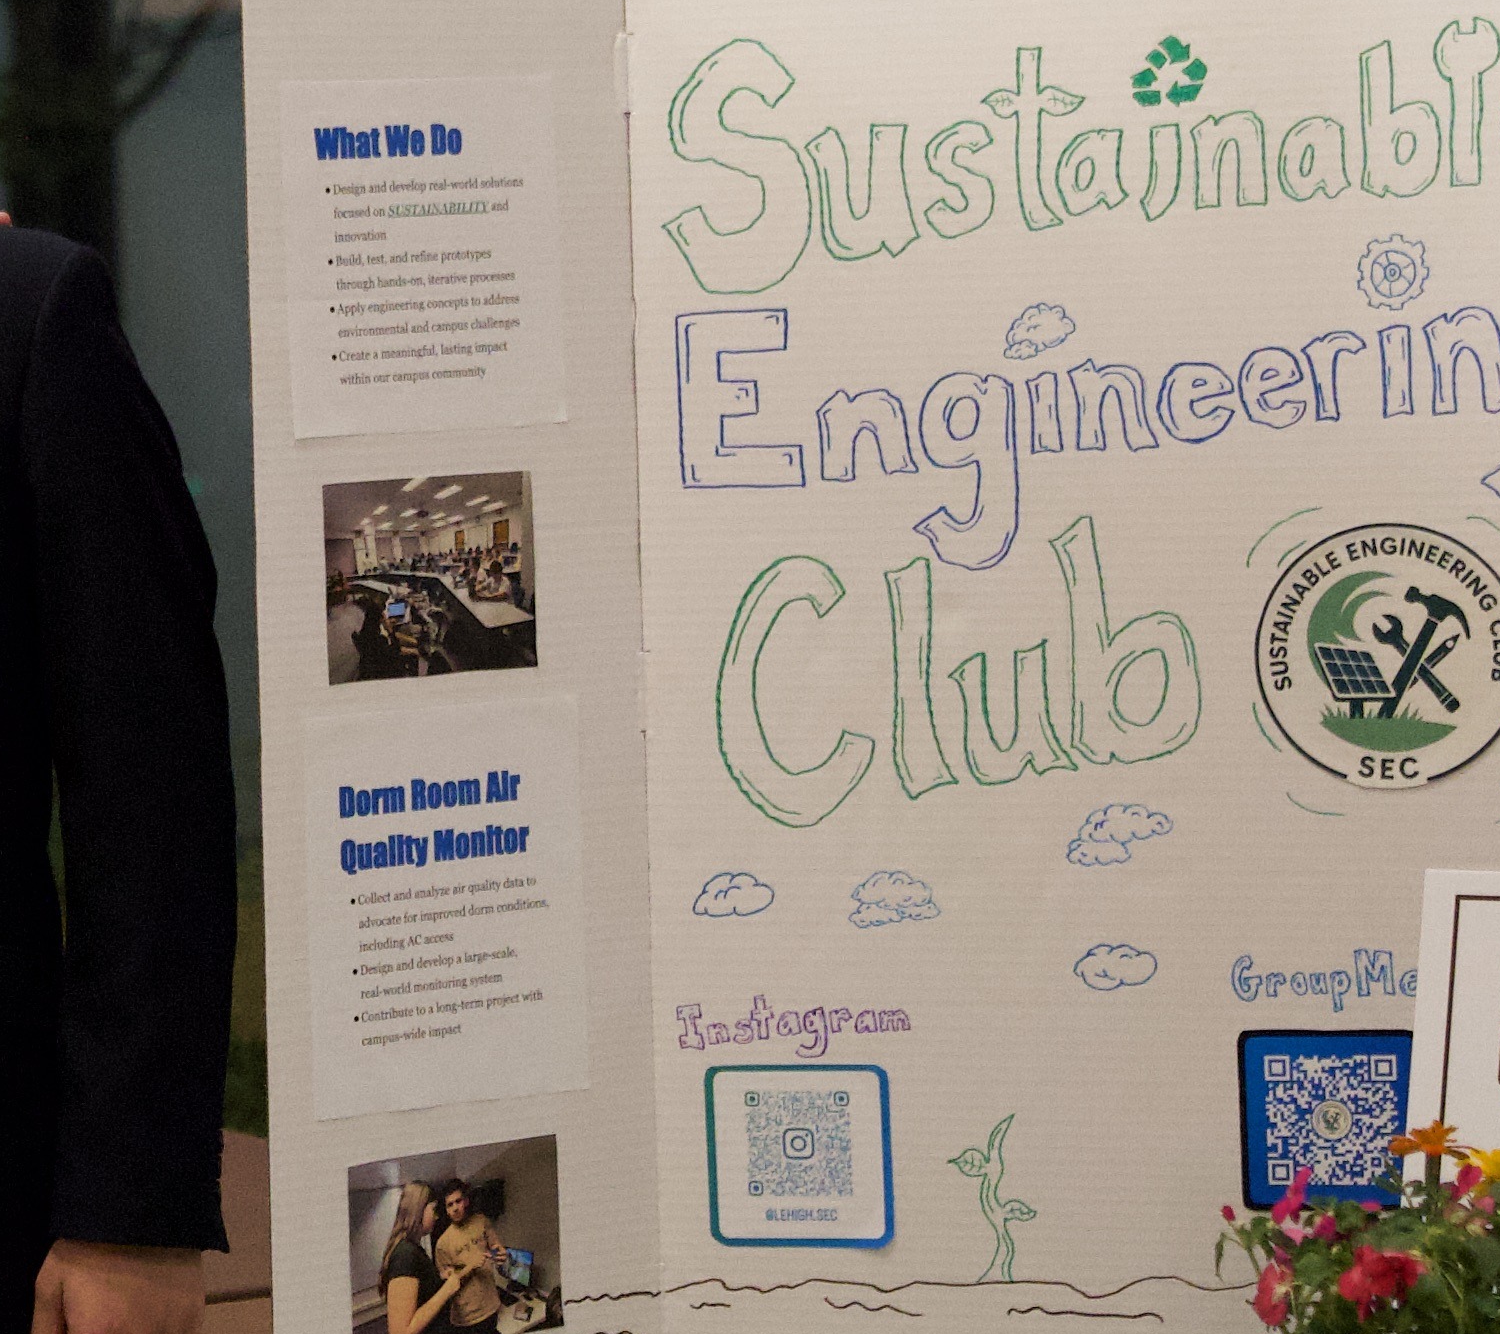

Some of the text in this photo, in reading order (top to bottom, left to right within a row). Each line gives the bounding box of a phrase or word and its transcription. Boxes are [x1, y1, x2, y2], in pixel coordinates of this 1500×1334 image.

[314, 124, 462, 160] What We Do
[333, 176, 523, 196] Design and develop real-world solutions
[334, 199, 509, 219] focused on SUSTAINABILITY and
[335, 229, 386, 242] innovation
[336, 249, 491, 267] Build, test, and refine prototypes
[337, 271, 515, 291] through hands-on, iterative processes
[338, 294, 519, 316] Apply engineering concepts to address
[338, 317, 520, 338] environmental and campus challenges
[339, 341, 507, 362] Create a meaningful, lasting impact
[340, 366, 486, 385] within our campus community
[1269, 551, 1342, 691] SUSTAINABLE
[1346, 537, 1498, 613] ENGINEERING
[716, 517, 1201, 828] Club
[1358, 756, 1419, 780] SEC
[339, 770, 520, 818] Dorm Room Air
[340, 825, 529, 875] Quality Monitor
[358, 877, 536, 905] Collect and analyze air quality data to
[359, 914, 401, 929] advocate
[404, 912, 417, 924] for
[420, 907, 466, 923] improved
[468, 903, 494, 915] dorm
[359, 932, 454, 952] including AC access
[360, 964, 393, 976] Design
[396, 958, 414, 971] and
[417, 955, 454, 969] develop
[360, 973, 502, 999] real-world monitoring system
[1232, 948, 1417, 1013] GroupMe
[361, 989, 543, 1023] Contribute to a long-term project with
[361, 1024, 461, 1046] campus-wide impact
[676, 994, 911, 1058] Instagram
[765, 1209, 838, 1221] @LEHIGH.SEC
